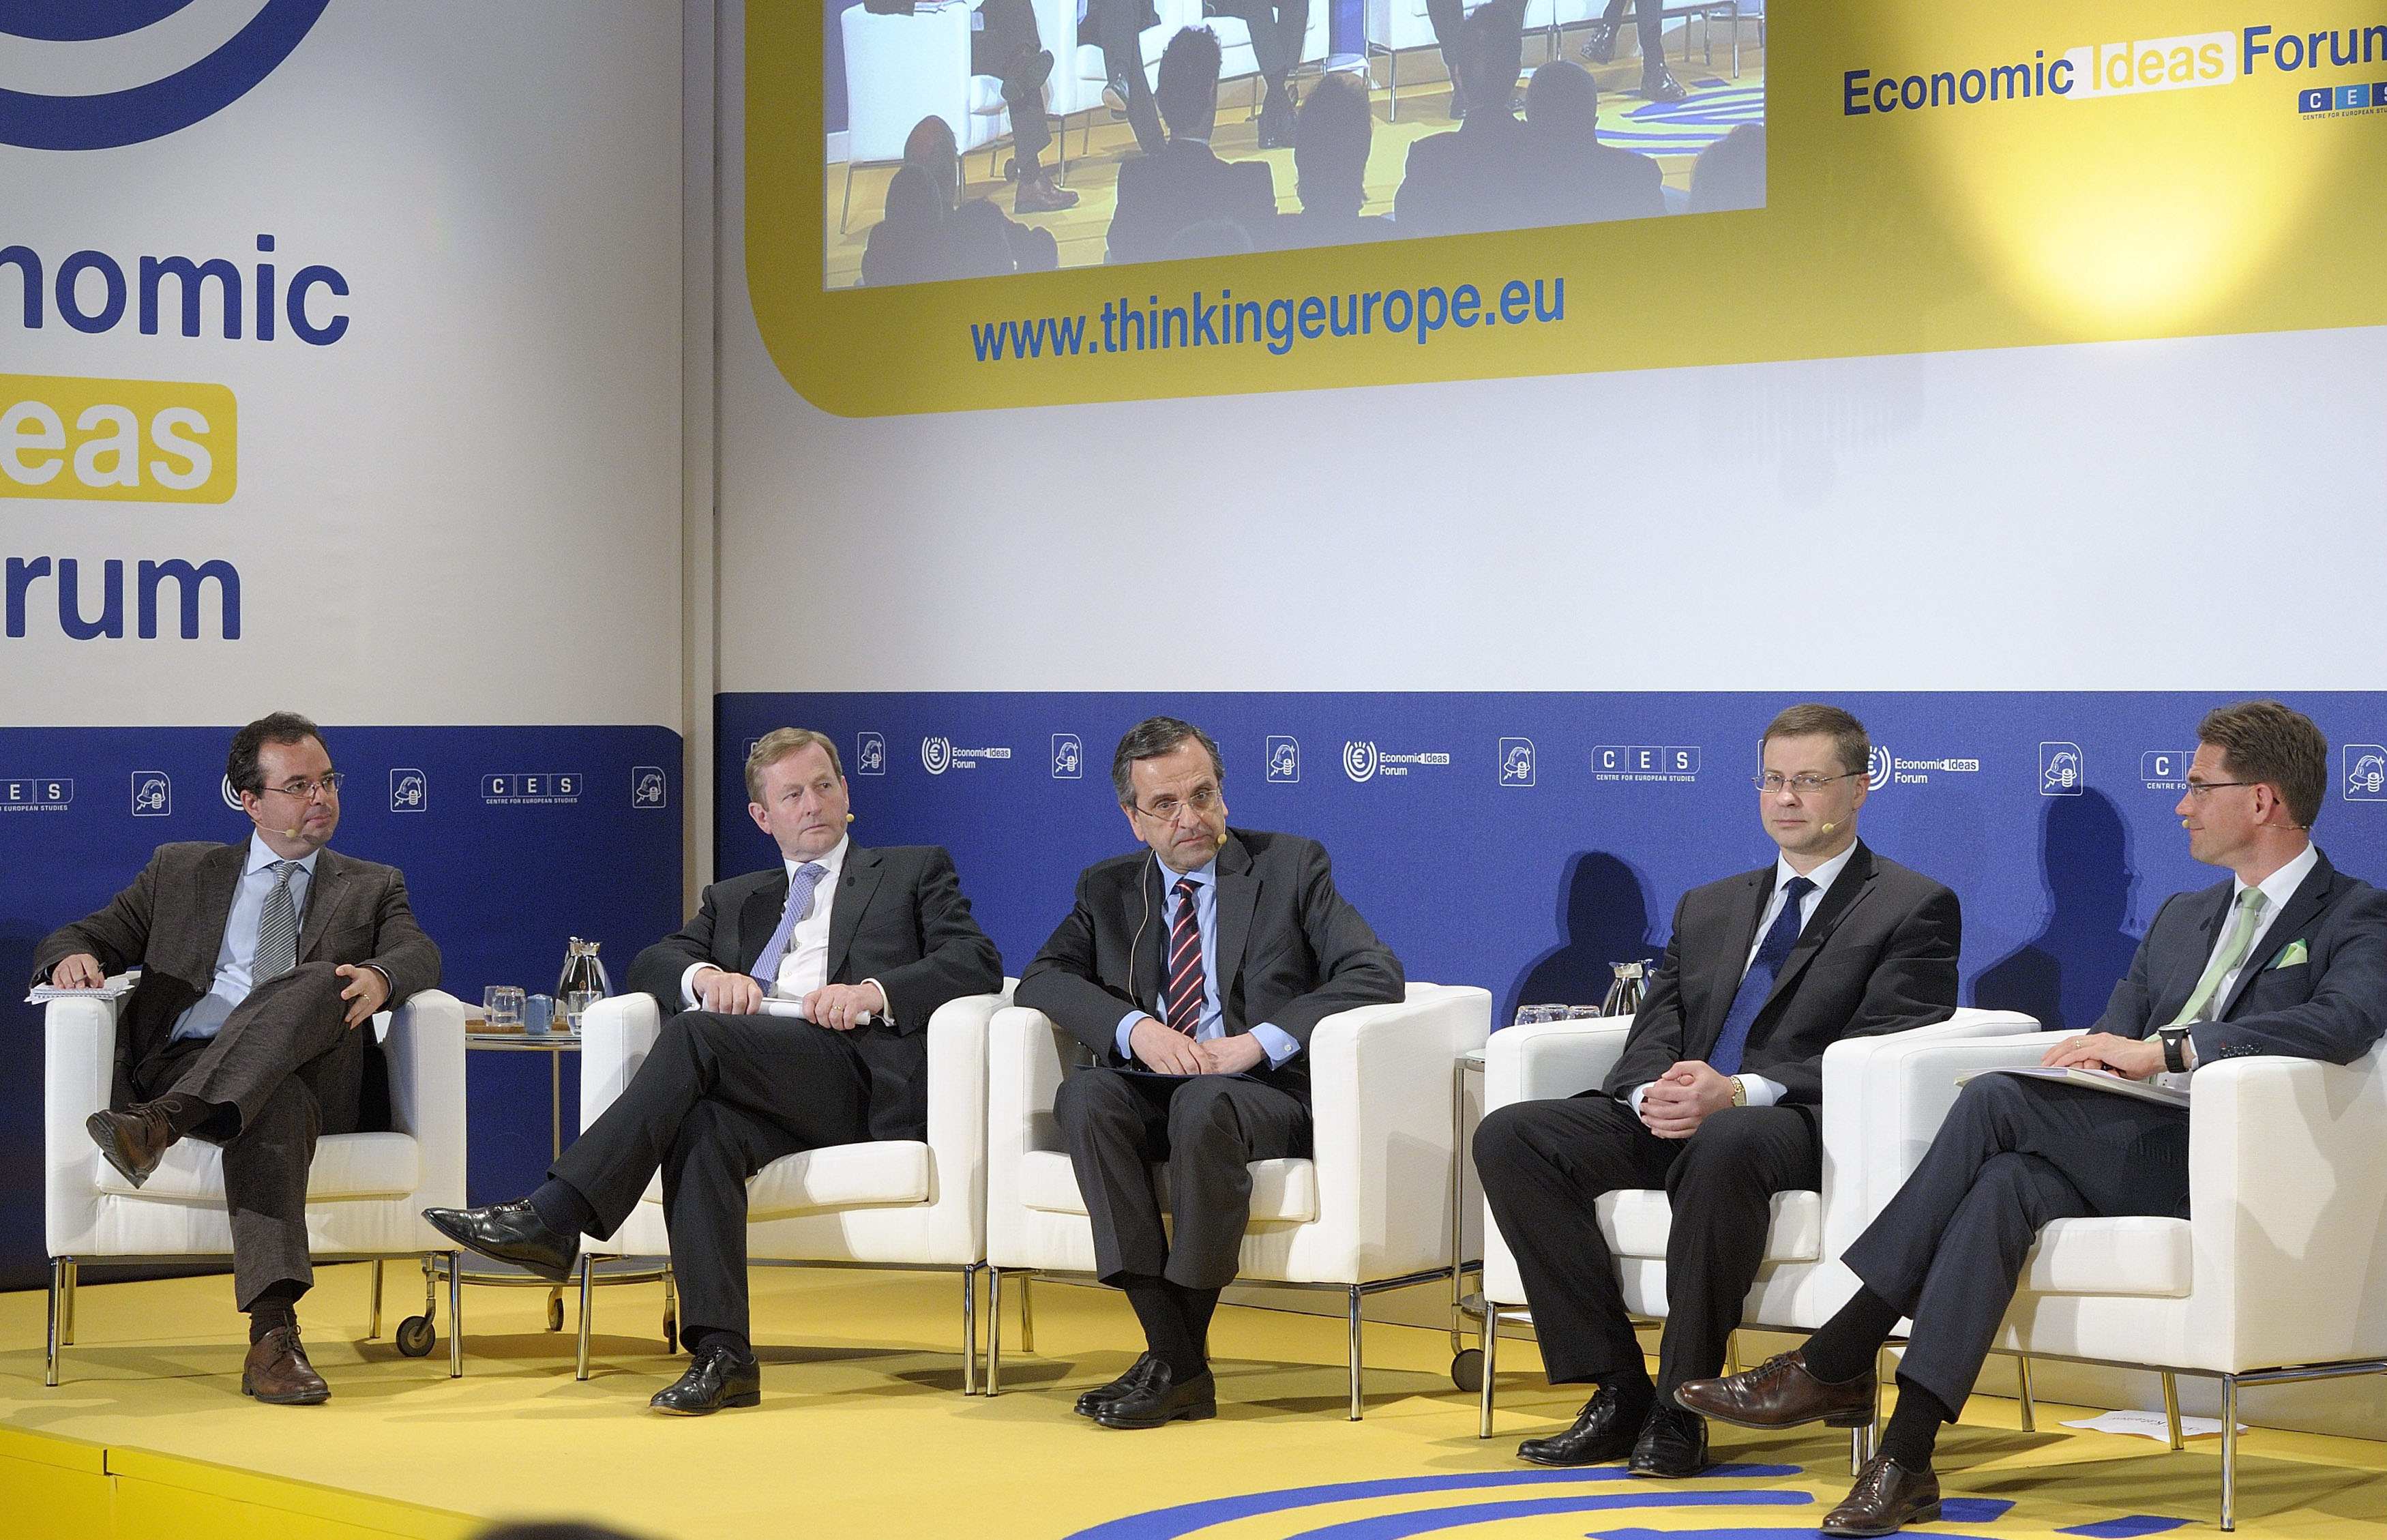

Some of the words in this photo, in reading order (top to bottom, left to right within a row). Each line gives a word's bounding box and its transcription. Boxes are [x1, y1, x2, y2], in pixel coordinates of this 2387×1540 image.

[1843, 50, 2074, 115] Economic
[2092, 41, 2224, 91] Ideas
[970, 277, 1565, 361] www.thinkingeurope.eu
[0, 400, 213, 490] eas
[5, 556, 241, 640] rum
[952, 747, 988, 757] Economic
[989, 747, 1009, 757] Ideas
[1380, 752, 1422, 763] Economic
[1424, 753, 1447, 763] Ideas
[952, 759, 976, 769] Forum
[1380, 765, 1408, 775] Forum
[1894, 758, 1945, 770] Economic
[1948, 759, 1976, 770] Ideas
[1895, 771, 1928, 784] Forum
